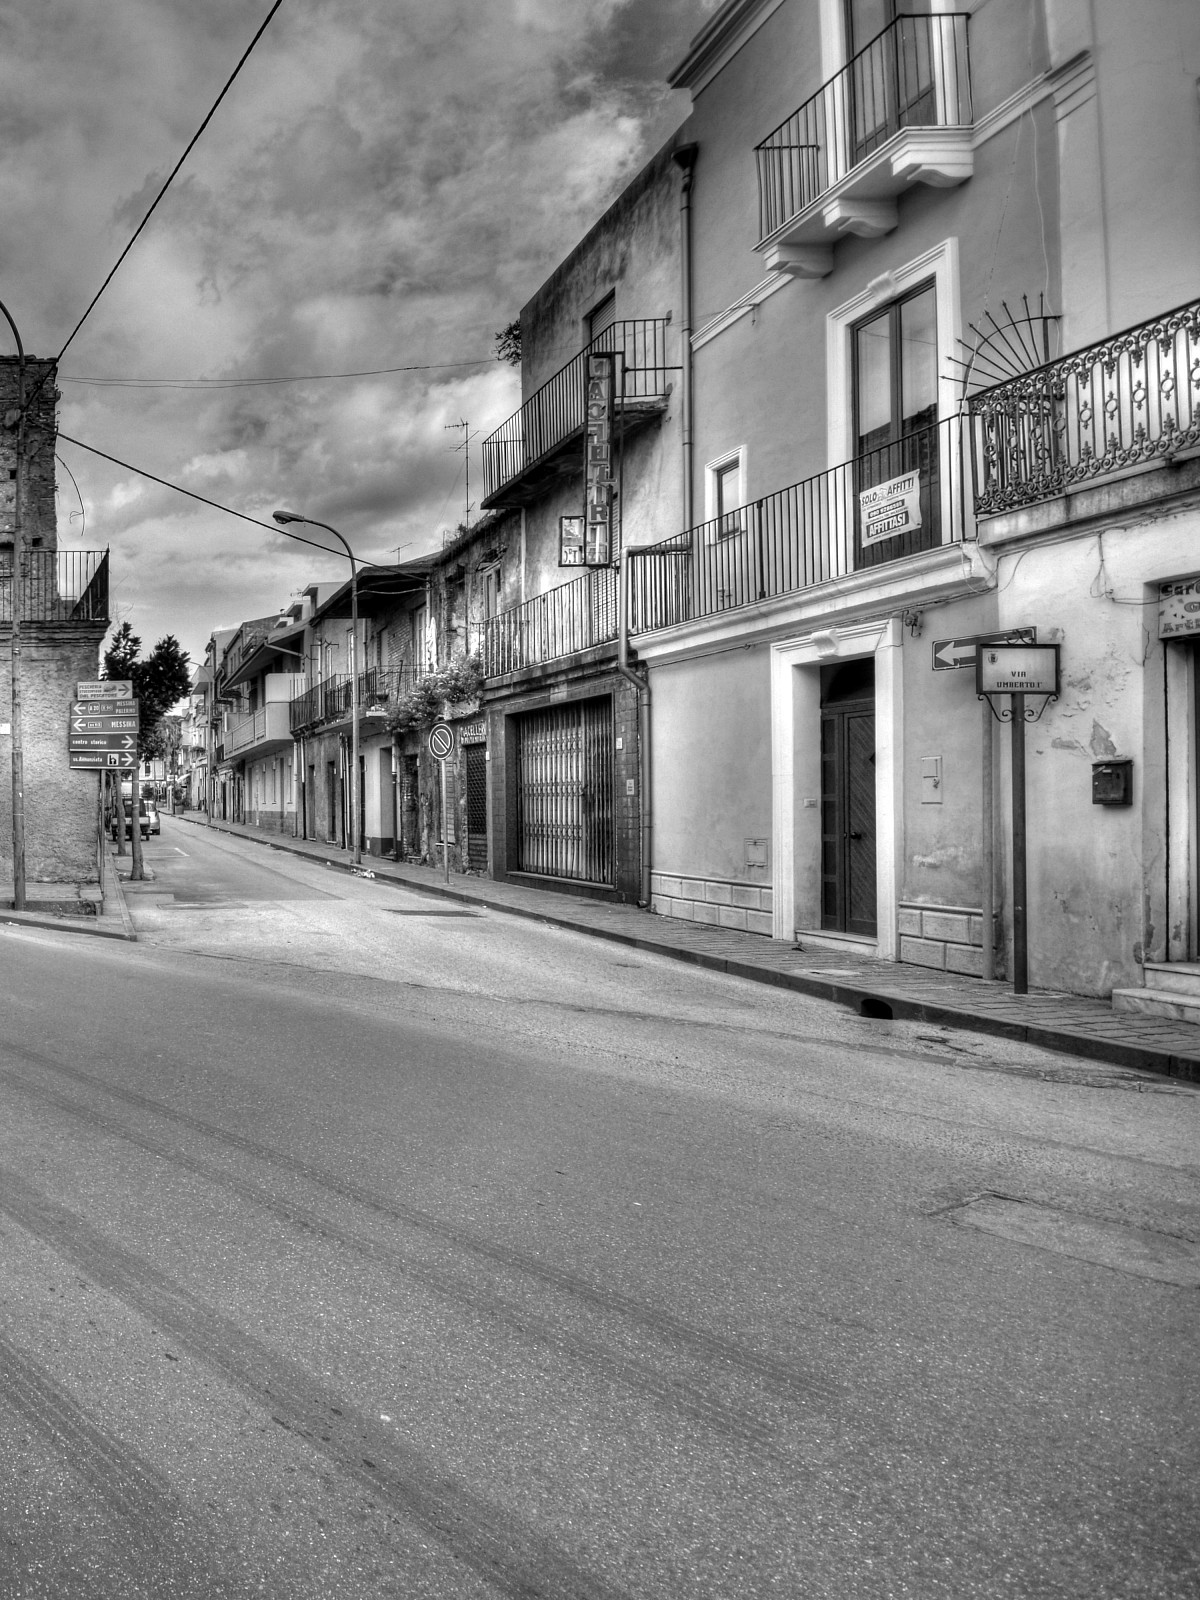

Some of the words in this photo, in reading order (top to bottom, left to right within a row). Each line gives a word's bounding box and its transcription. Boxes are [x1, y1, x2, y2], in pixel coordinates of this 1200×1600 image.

[862, 491, 878, 506] SOLO
[887, 477, 914, 496] AFFITTI
[869, 513, 906, 537] AFFITTASI
[996, 681, 1035, 689] UMBERTO
